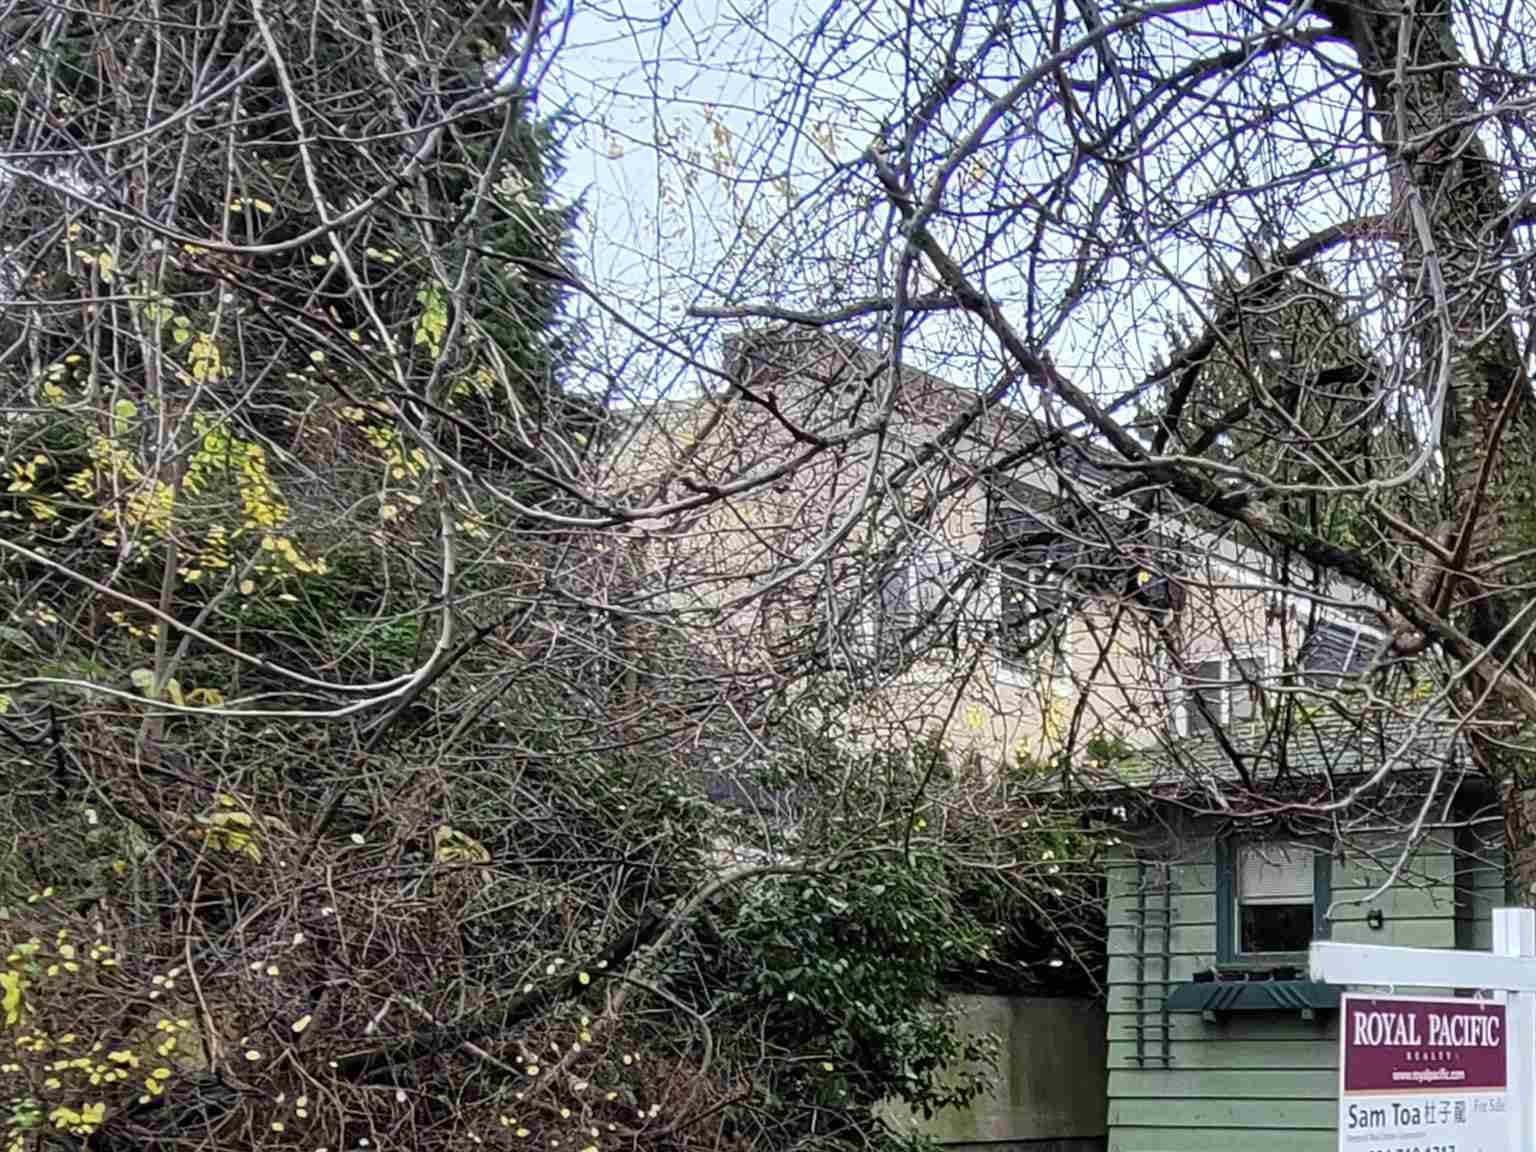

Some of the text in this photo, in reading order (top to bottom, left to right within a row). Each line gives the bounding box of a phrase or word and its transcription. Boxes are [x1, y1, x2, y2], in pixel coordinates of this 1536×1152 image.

[1353, 1011, 1500, 1047] ROYAL PACIFIC
[1406, 1051, 1452, 1061] REALTY
[1348, 1103, 1386, 1129] Sam
[1391, 1102, 1422, 1126] Toa
